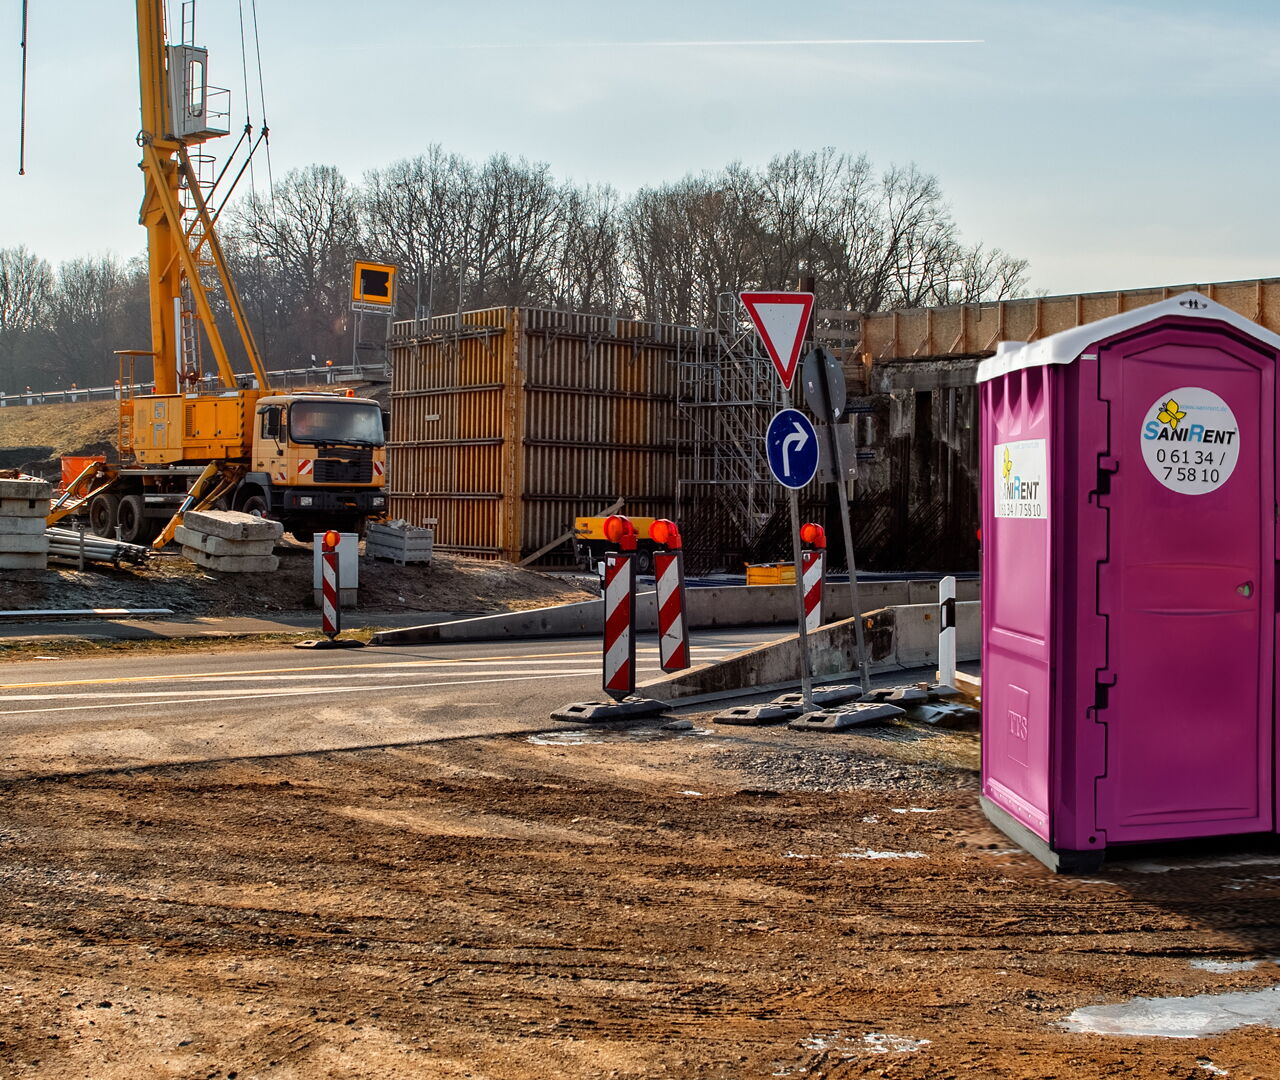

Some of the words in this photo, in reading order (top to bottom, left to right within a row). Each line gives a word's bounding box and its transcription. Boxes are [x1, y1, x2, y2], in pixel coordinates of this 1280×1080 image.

[1156, 448, 1166, 463] 0
[1170, 449, 1190, 464] 61
[1194, 450, 1214, 465] 34
[1219, 452, 1226, 466] /
[1163, 466, 1173, 480] 7
[1176, 467, 1197, 482] 58
[1201, 469, 1220, 483] 10
[1008, 709, 1028, 741] TTS
